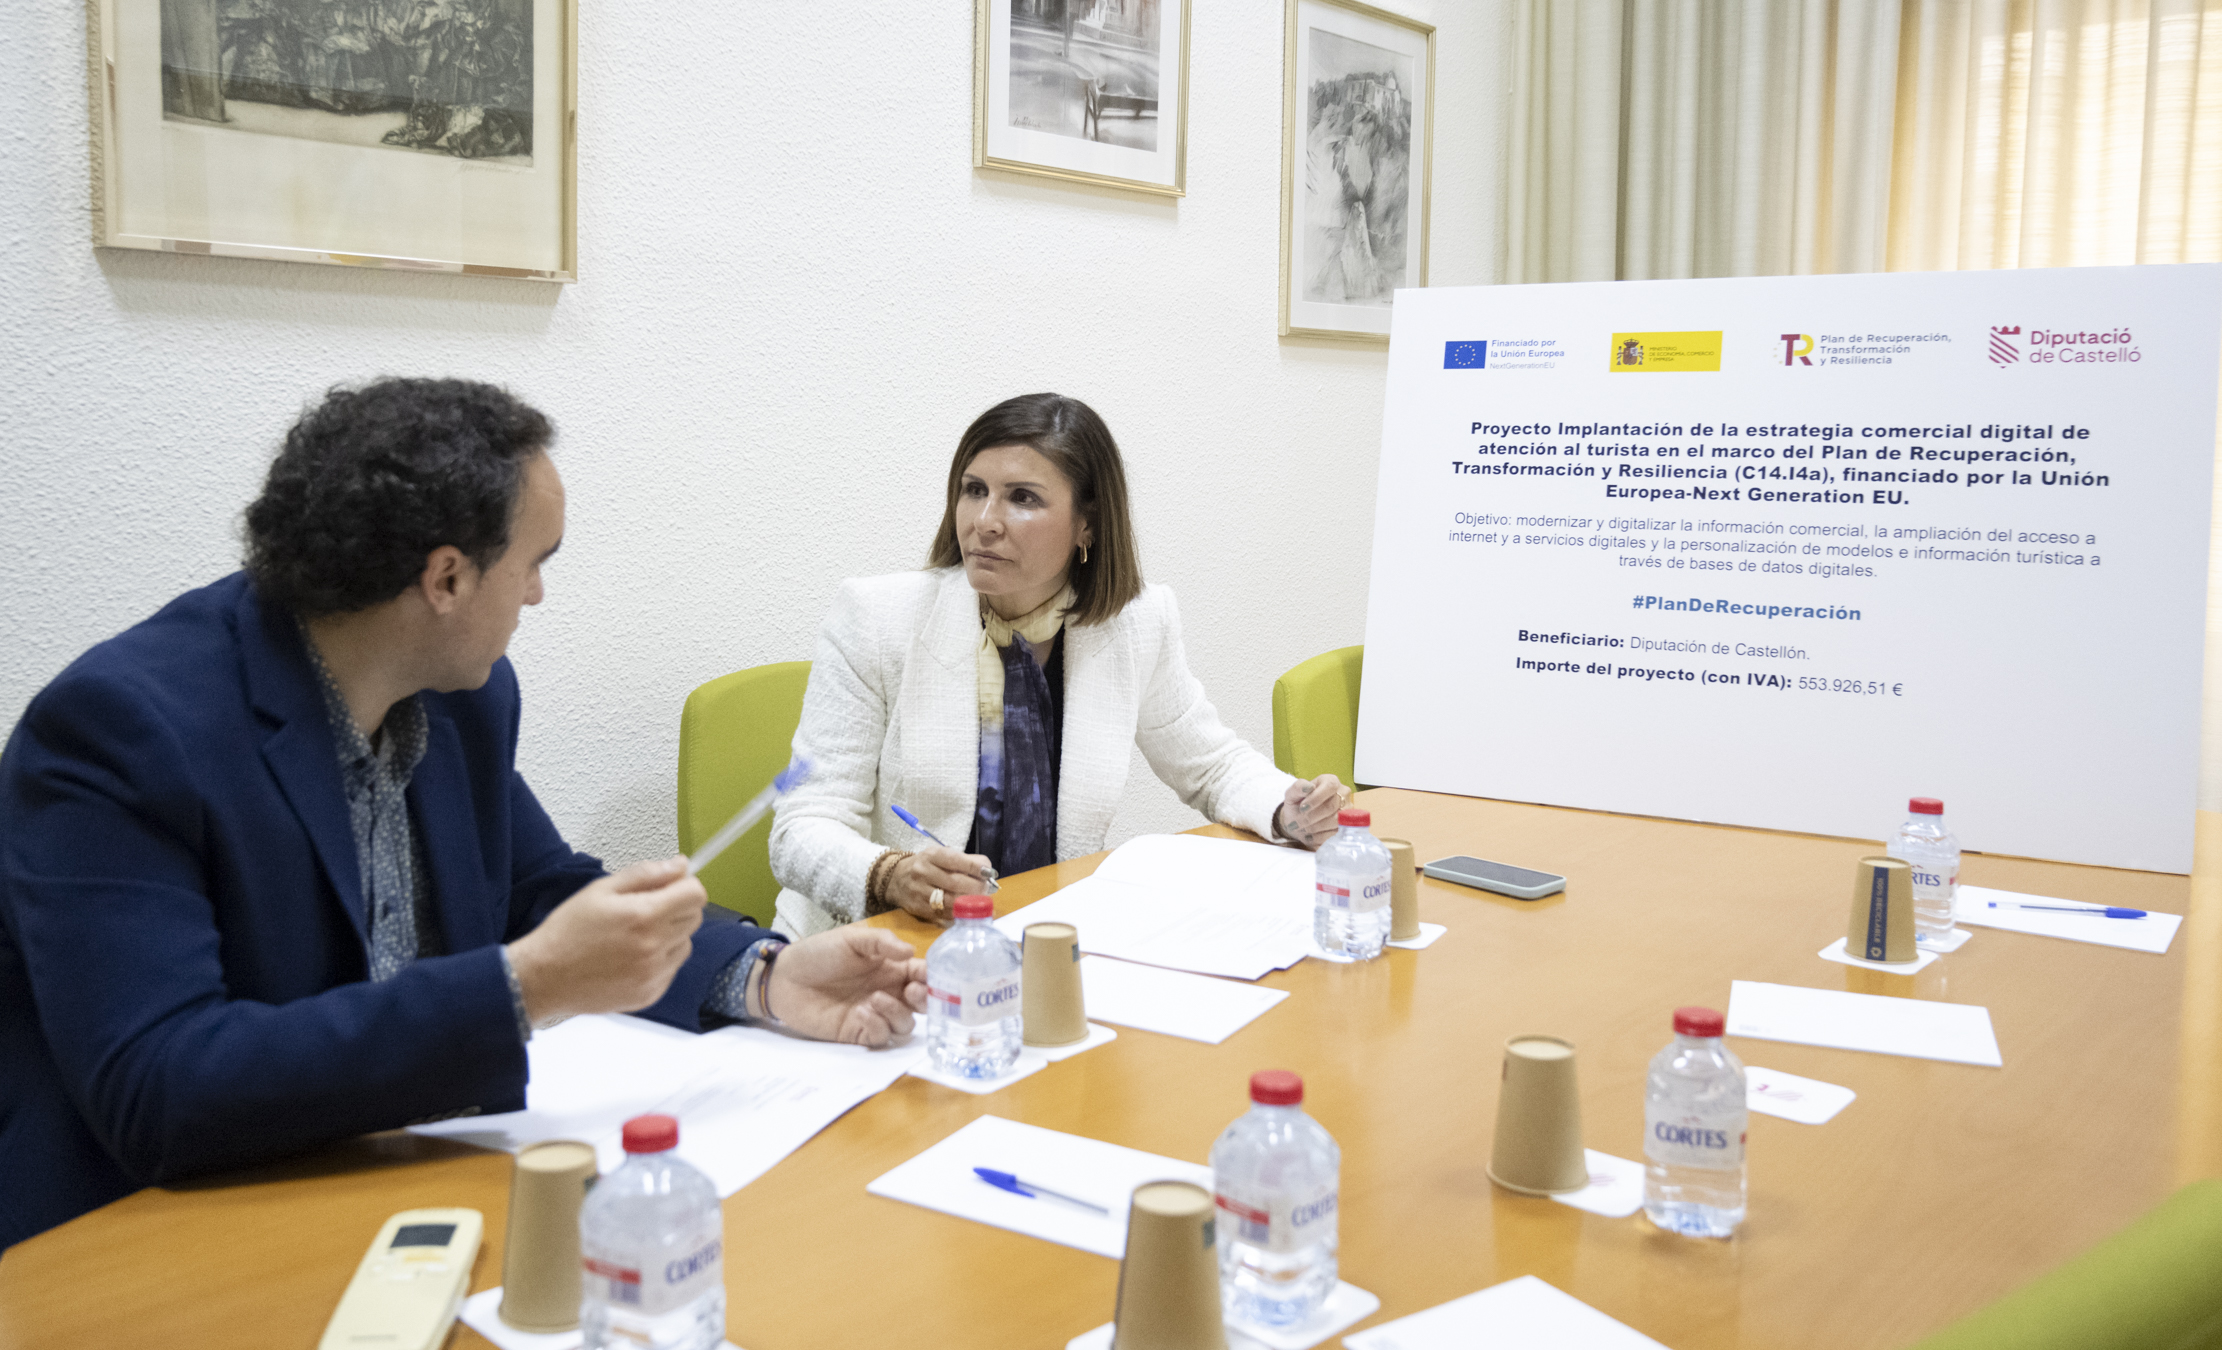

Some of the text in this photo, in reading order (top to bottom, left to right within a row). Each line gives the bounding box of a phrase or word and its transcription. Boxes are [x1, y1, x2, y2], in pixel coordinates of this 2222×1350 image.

[1491, 339, 1557, 348] Financiado por
[1820, 332, 1952, 344] Plan de Recuperación,
[2030, 327, 2132, 349] Diputació
[1490, 349, 1565, 359] la Unión Europea
[1819, 344, 1911, 355] Transformación
[2029, 345, 2142, 364] de Castelló
[1489, 361, 1556, 370] NextGenerationEU
[1819, 355, 1893, 367] y Resiliencia
[1471, 421, 2090, 443] Proyecto Implantación de la estrategia comercial digital de
[1478, 442, 2076, 466] atención al turista en el marco del Plan de Recuperación,
[1451, 461, 1595, 477] Transformación
[1601, 466, 1613, 481] y
[1618, 463, 1728, 479] Resiliencia
[1842, 467, 1959, 484] financiado
[1966, 472, 2005, 488] por
[2012, 470, 2032, 485] la
[2041, 470, 2110, 487] Unión
[1606, 484, 1909, 505] Europea-Next Generation EU.
[1454, 511, 2096, 545] Objetivo: modernizar y digitalizar la información comercial, la ampliación del acceso a
[1448, 530, 2101, 566] internet y a servicios digitales y la personalización de modelos e información turística a
[1619, 554, 1879, 579] través de bases de datos digitales.
[1632, 595, 1861, 621] #PlanDeRecuperación
[1518, 629, 1810, 660] Beneficiario: Diputación de Castellón.
[1516, 656, 1903, 697] Importe del proyecto (con IVA): 553.926,51 €
[1911, 872, 1941, 886] RTES
[977, 983, 1019, 1008] CORTES
[1654, 1121, 1729, 1150] CORTES
